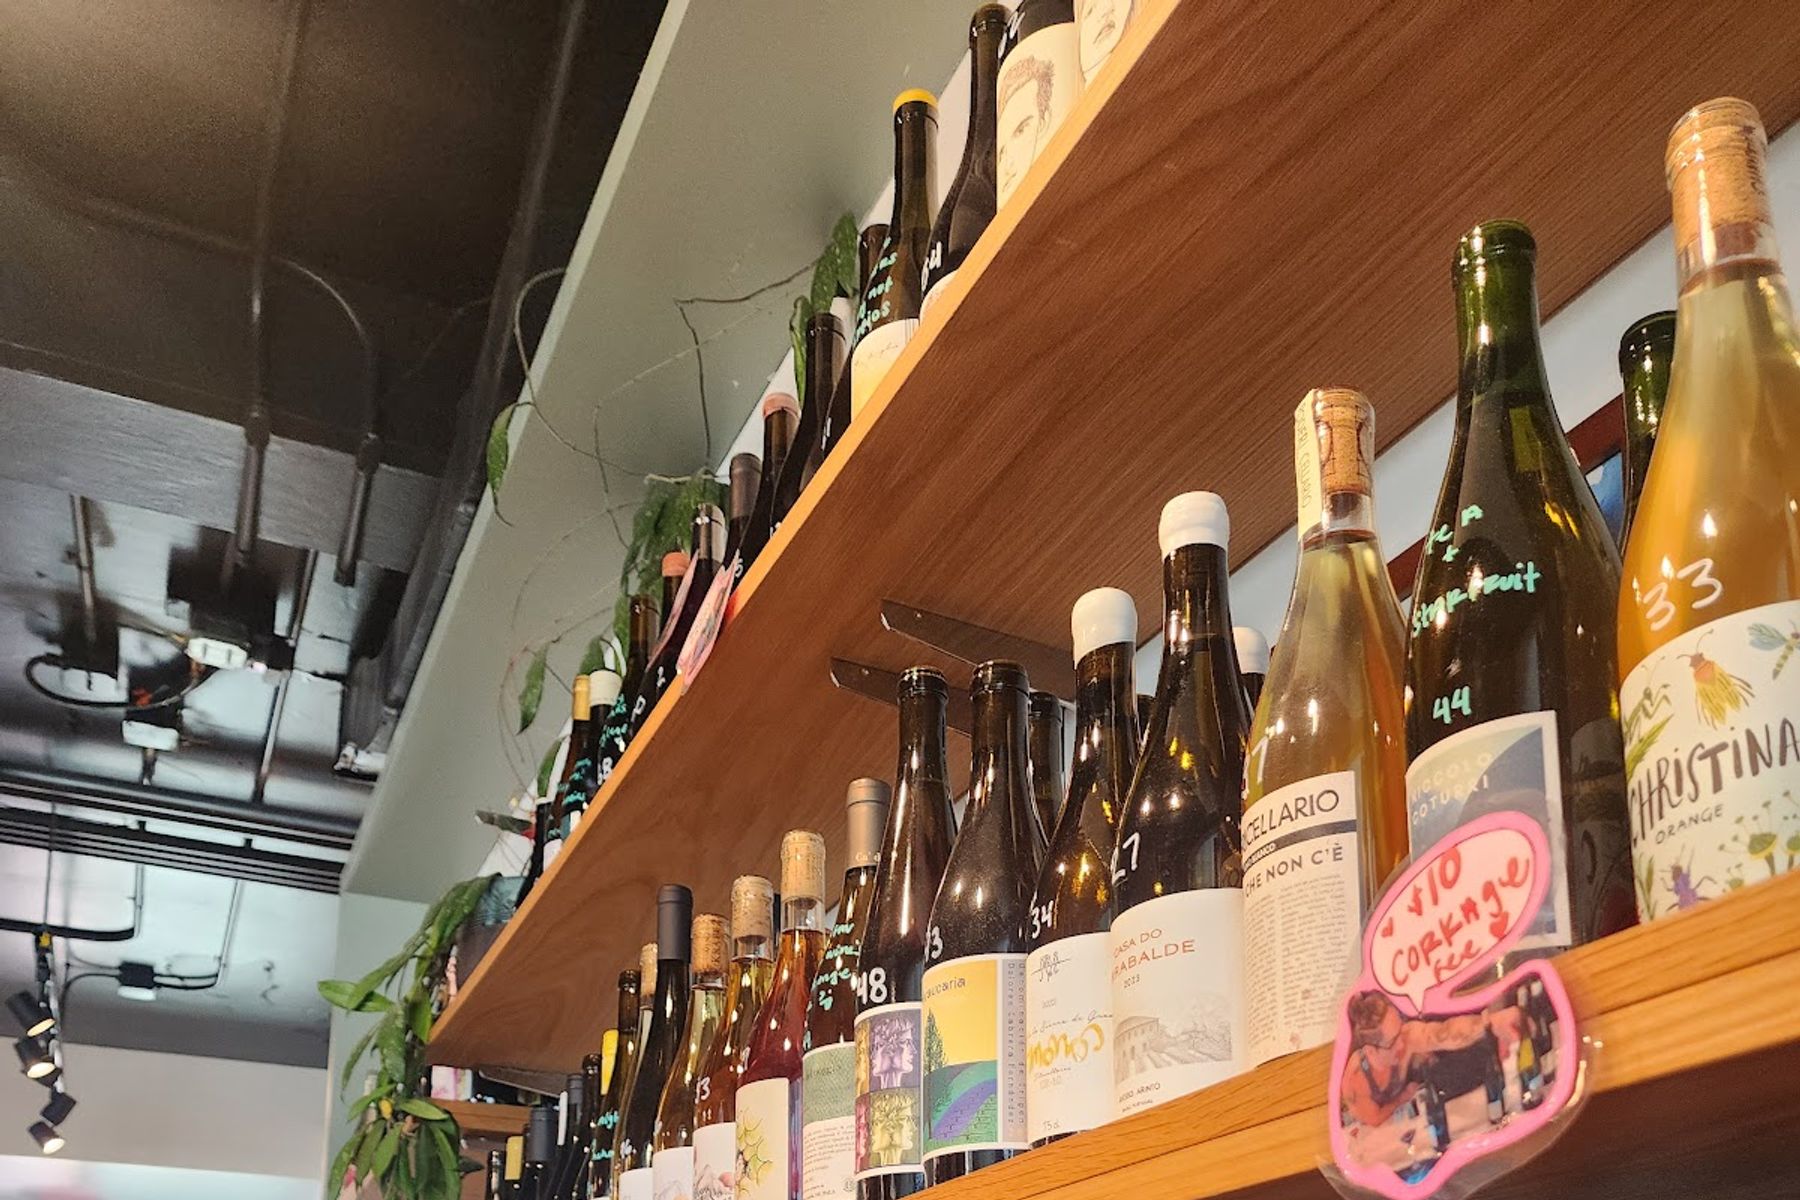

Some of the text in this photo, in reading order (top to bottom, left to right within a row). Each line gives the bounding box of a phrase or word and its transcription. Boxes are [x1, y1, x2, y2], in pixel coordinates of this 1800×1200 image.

[1643, 558, 1723, 632] 33
[1433, 685, 1472, 725] 44
[1655, 803, 1724, 845] ORANGE
[1265, 854, 1303, 883] NON
[1139, 927, 1163, 944] DO
[862, 966, 889, 1005] 48
